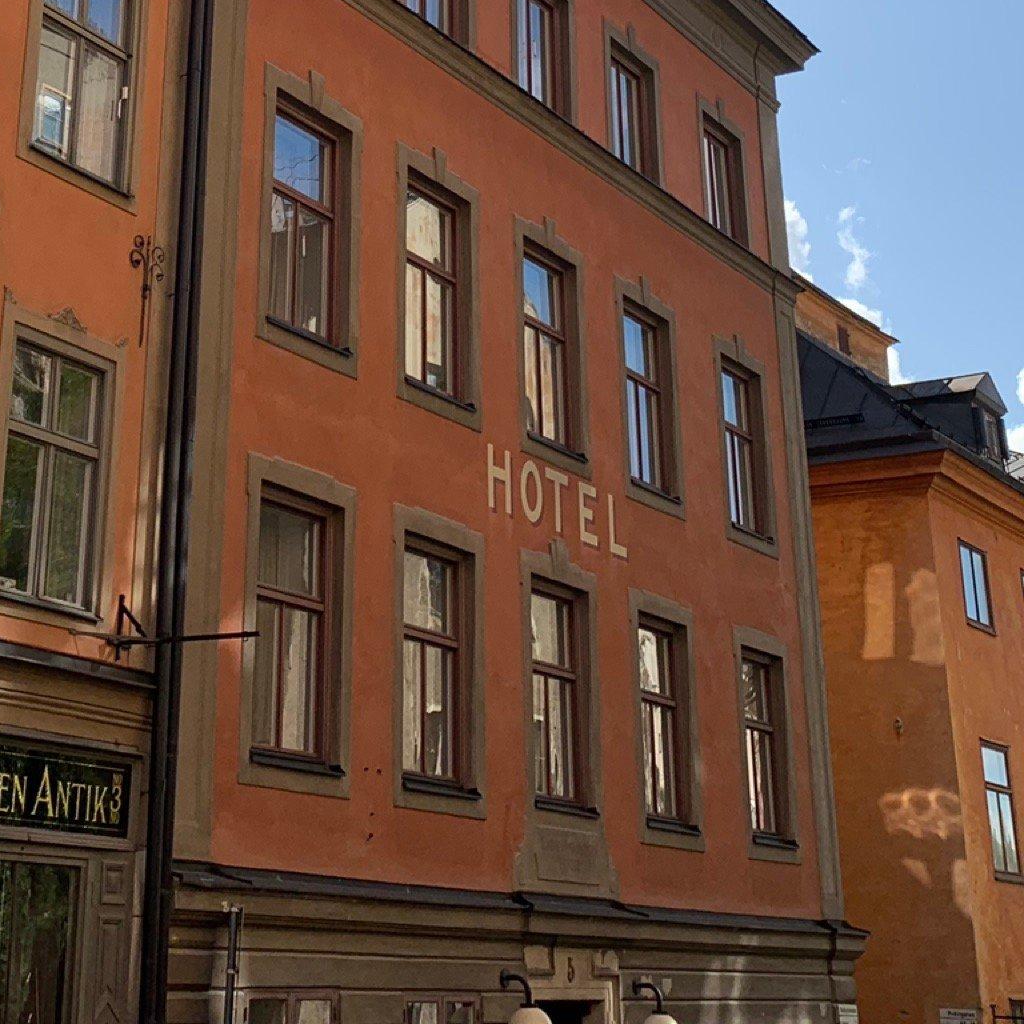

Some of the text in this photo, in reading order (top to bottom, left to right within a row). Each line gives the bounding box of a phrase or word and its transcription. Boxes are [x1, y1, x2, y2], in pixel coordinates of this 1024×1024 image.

[487, 442, 628, 559] HOTEL
[30, 764, 108, 824] ANTIK
[110, 786, 122, 812] 3
